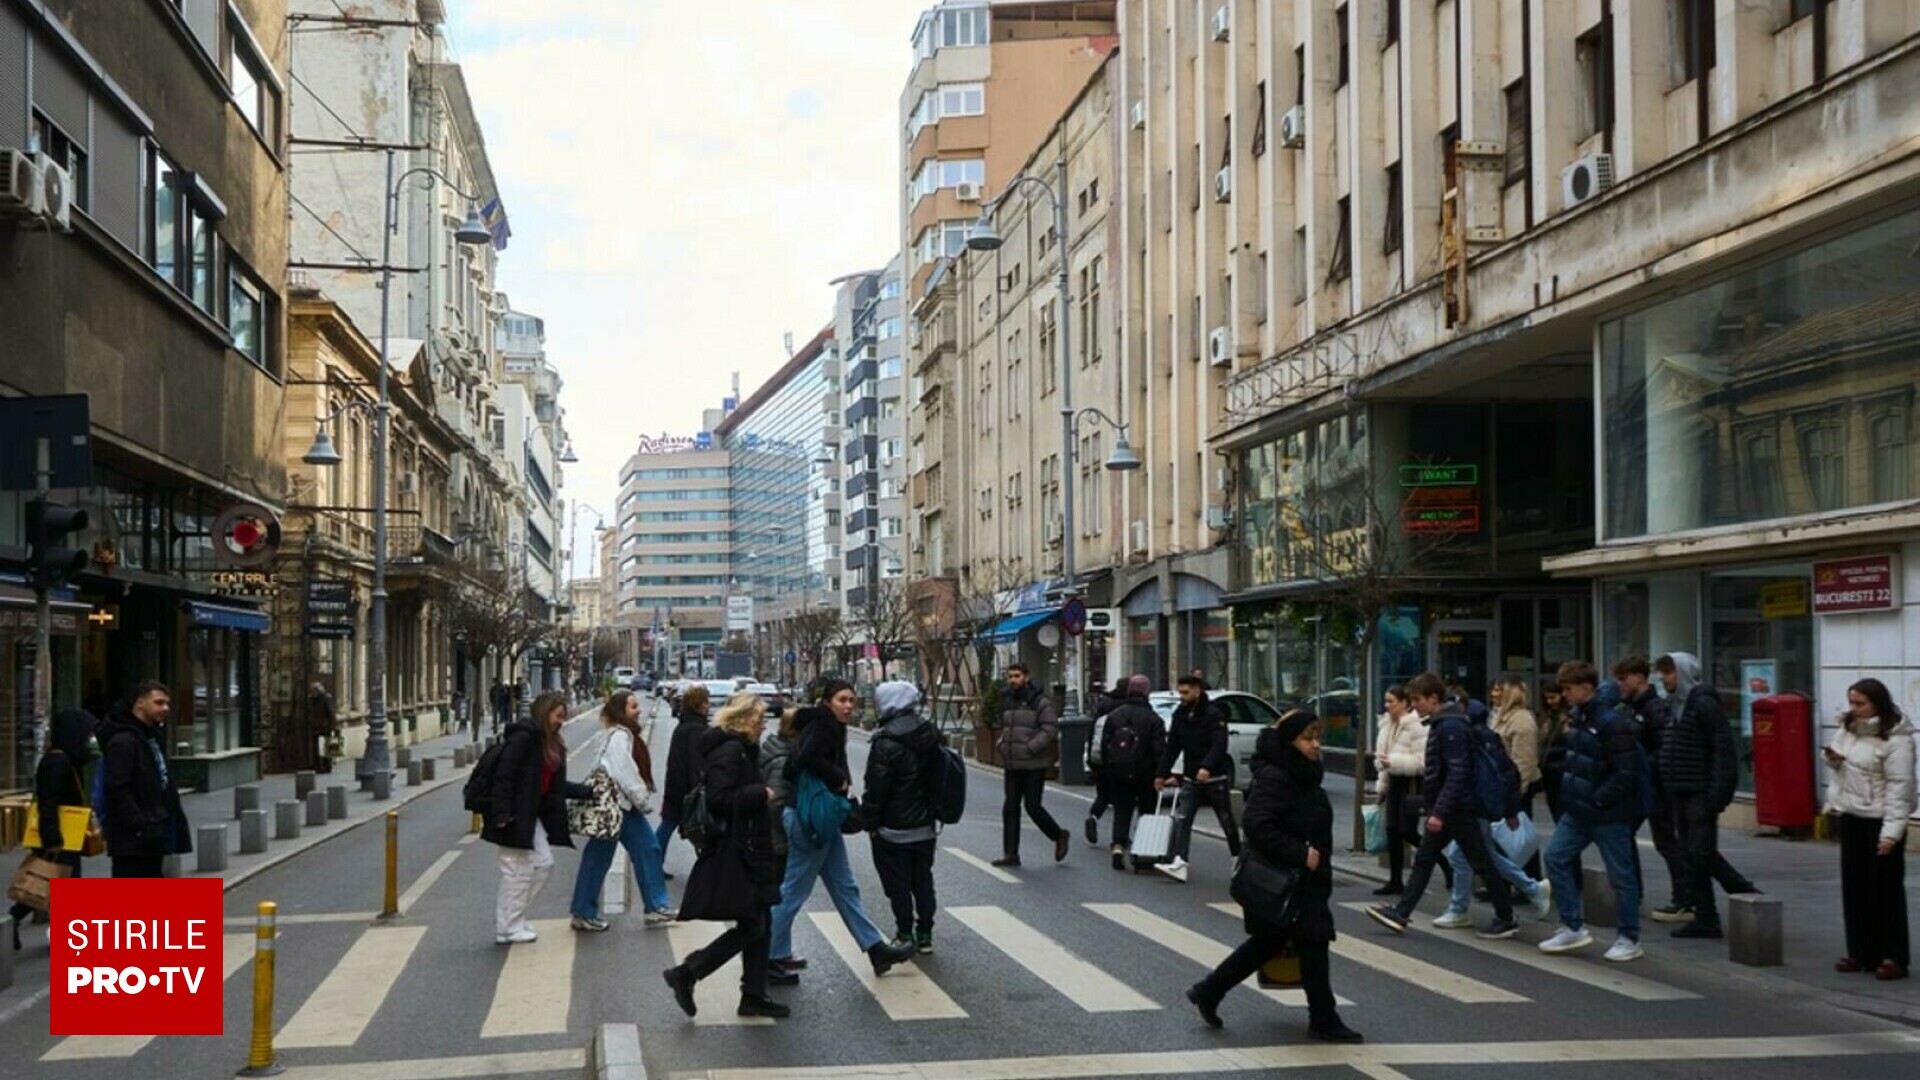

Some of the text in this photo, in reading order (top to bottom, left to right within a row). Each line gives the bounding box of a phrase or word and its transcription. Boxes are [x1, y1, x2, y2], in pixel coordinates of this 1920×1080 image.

[638, 431, 695, 453] Radisson
[1424, 470, 1457, 480] WANT
[210, 572, 279, 584] CENTRALE
[1877, 589, 1890, 600] 22
